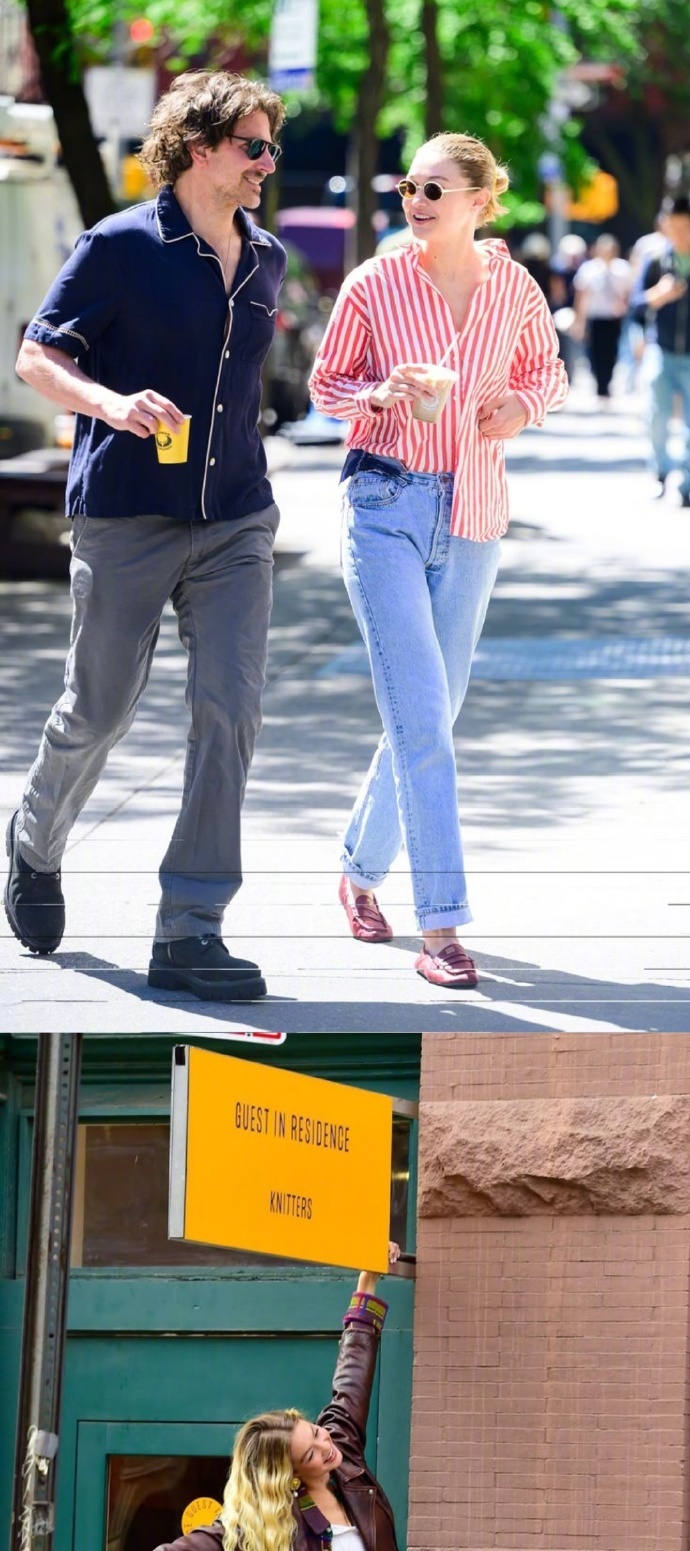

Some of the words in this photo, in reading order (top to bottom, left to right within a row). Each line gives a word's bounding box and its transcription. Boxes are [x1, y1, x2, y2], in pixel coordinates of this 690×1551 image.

[235, 1101, 269, 1135] GUEST
[274, 1110, 286, 1139] IN
[291, 1114, 350, 1153] RESIDENCE
[269, 1190, 312, 1220] KNITTERS
[185, 1500, 213, 1518] GUEST
